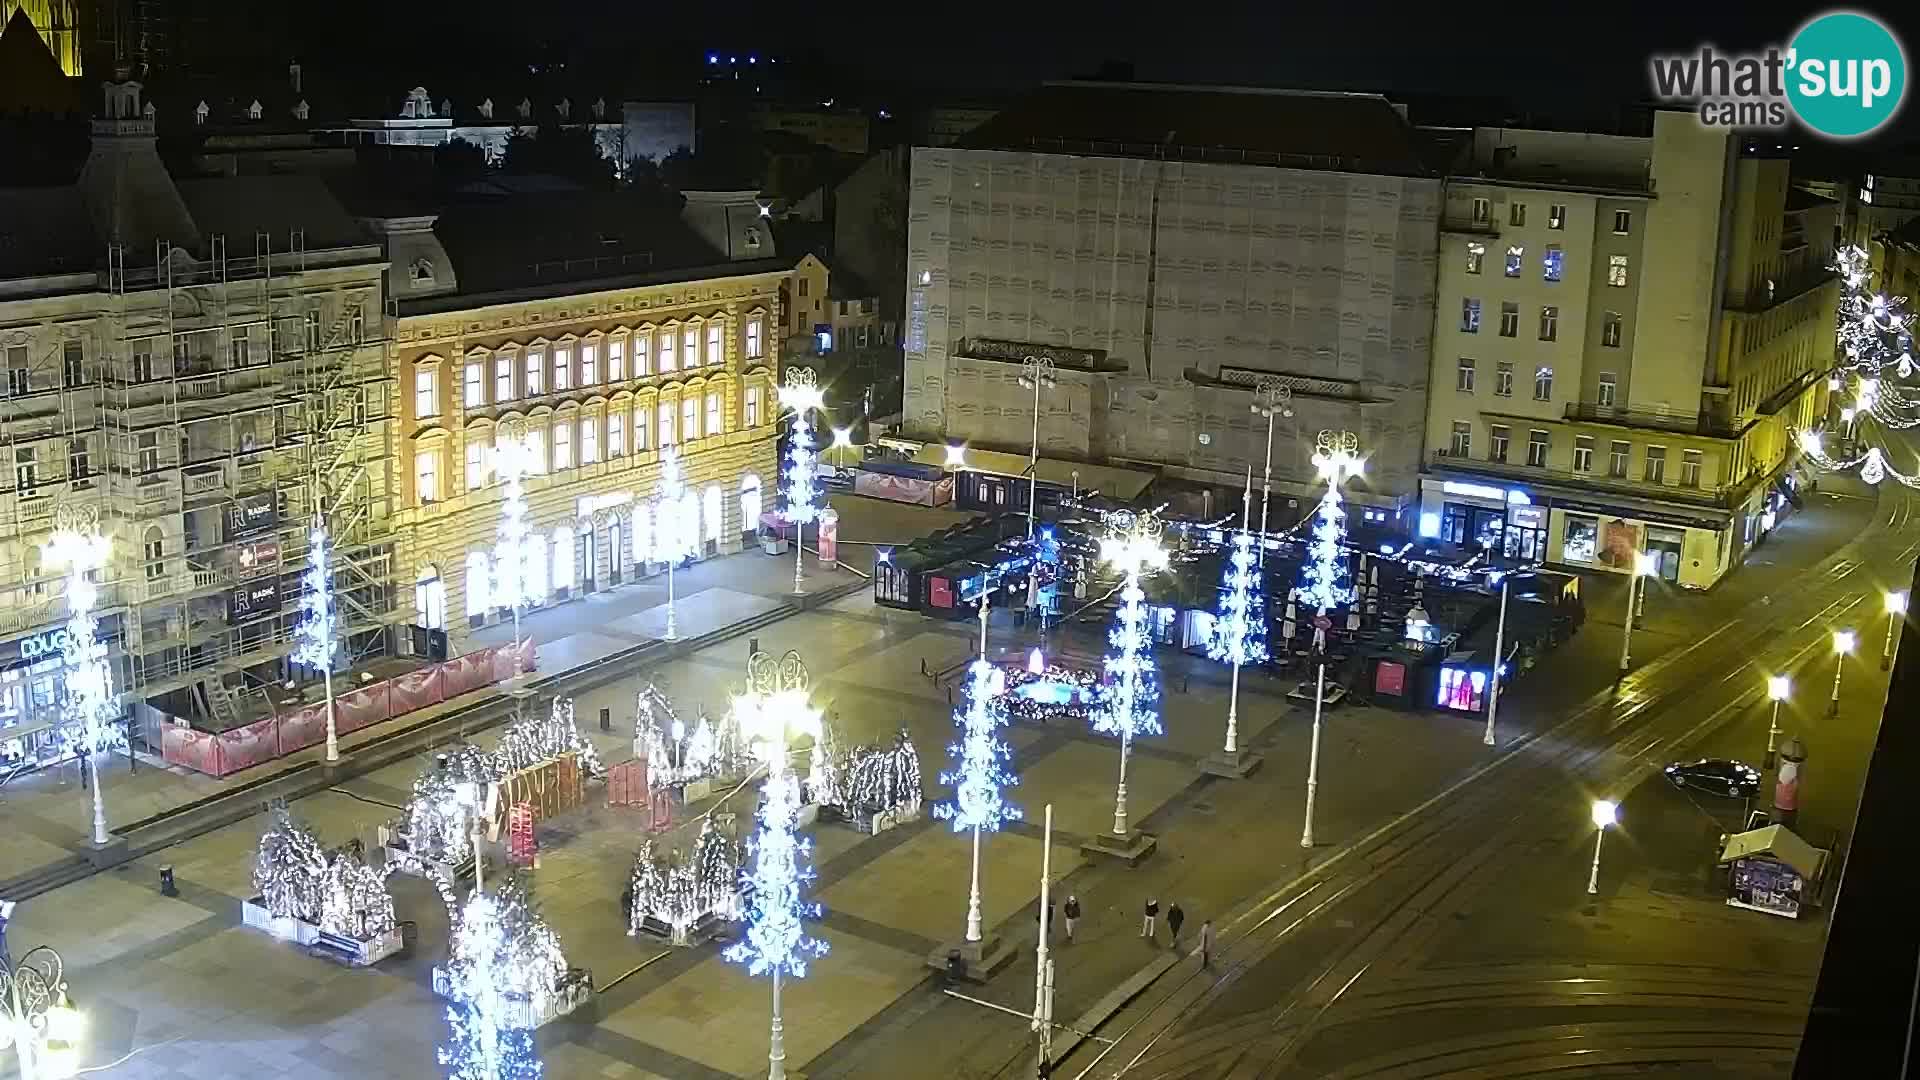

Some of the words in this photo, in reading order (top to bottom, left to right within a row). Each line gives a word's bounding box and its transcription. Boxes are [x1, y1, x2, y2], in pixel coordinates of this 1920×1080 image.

[231, 508, 247, 529] R
[234, 590, 250, 612] R
[21, 630, 67, 658] DOUG
